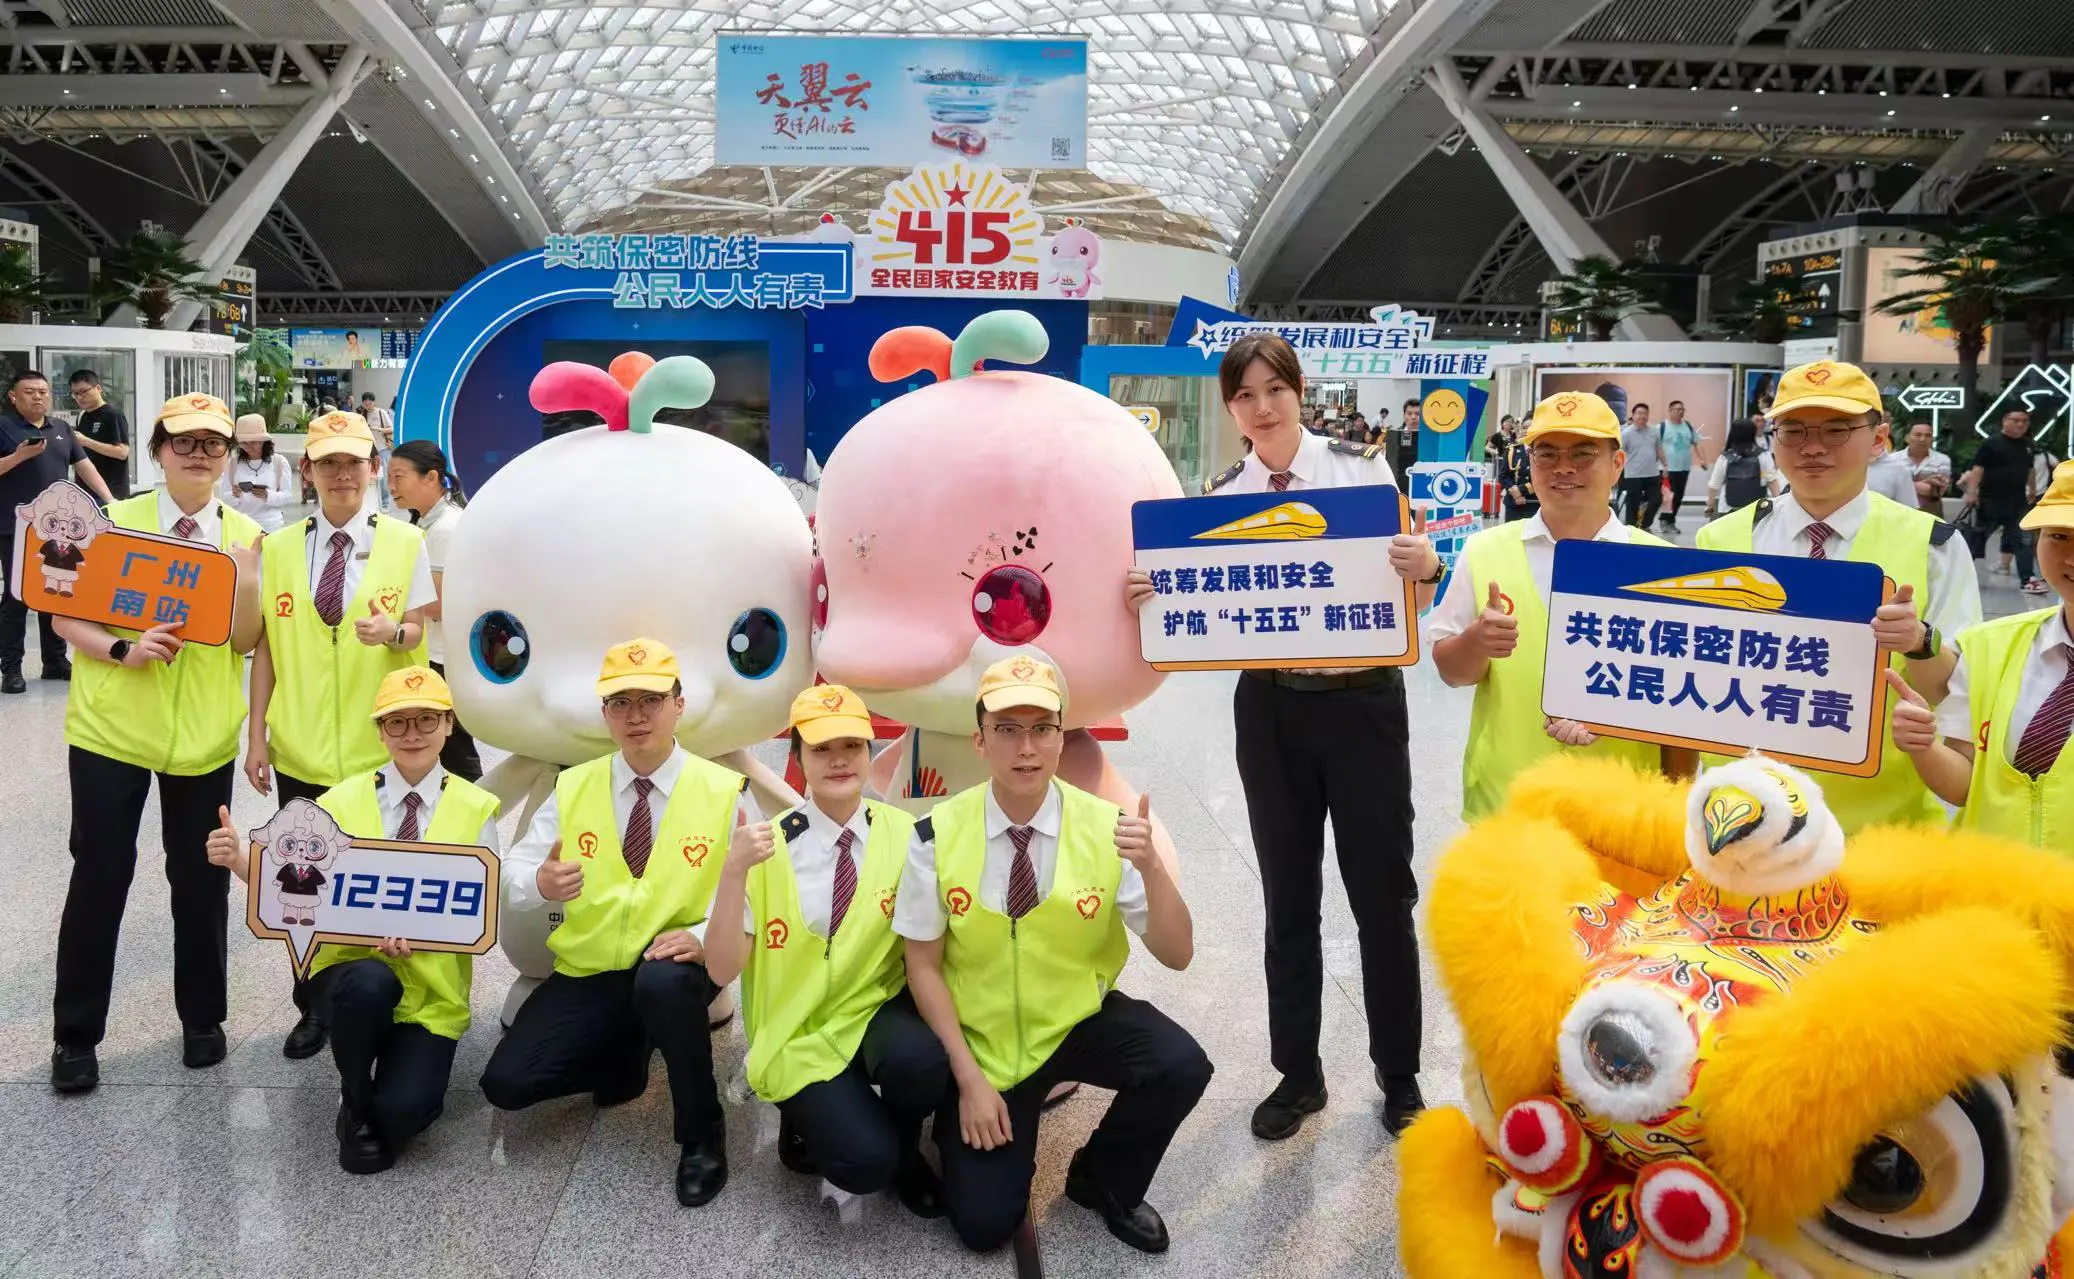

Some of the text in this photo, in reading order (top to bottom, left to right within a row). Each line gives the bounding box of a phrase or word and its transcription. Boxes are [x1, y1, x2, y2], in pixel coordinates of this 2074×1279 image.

[756, 62, 872, 113] 天翼云
[544, 234, 759, 269] 共筑保密防线
[896, 211, 1011, 265] 415
[612, 273, 825, 308] 公民人人有责
[871, 268, 1039, 291] 全民国家安全教育
[1220, 327, 1410, 349] 统发展和安全
[121, 552, 201, 590] 广州
[1150, 561, 1335, 595] 统筹发展和安全
[110, 588, 190, 625] 南站
[1565, 610, 1830, 678] 共筑保密防线
[1585, 661, 1854, 733] 公民人人有责
[331, 872, 484, 917] 12339
[548, 912, 564, 923] 中
